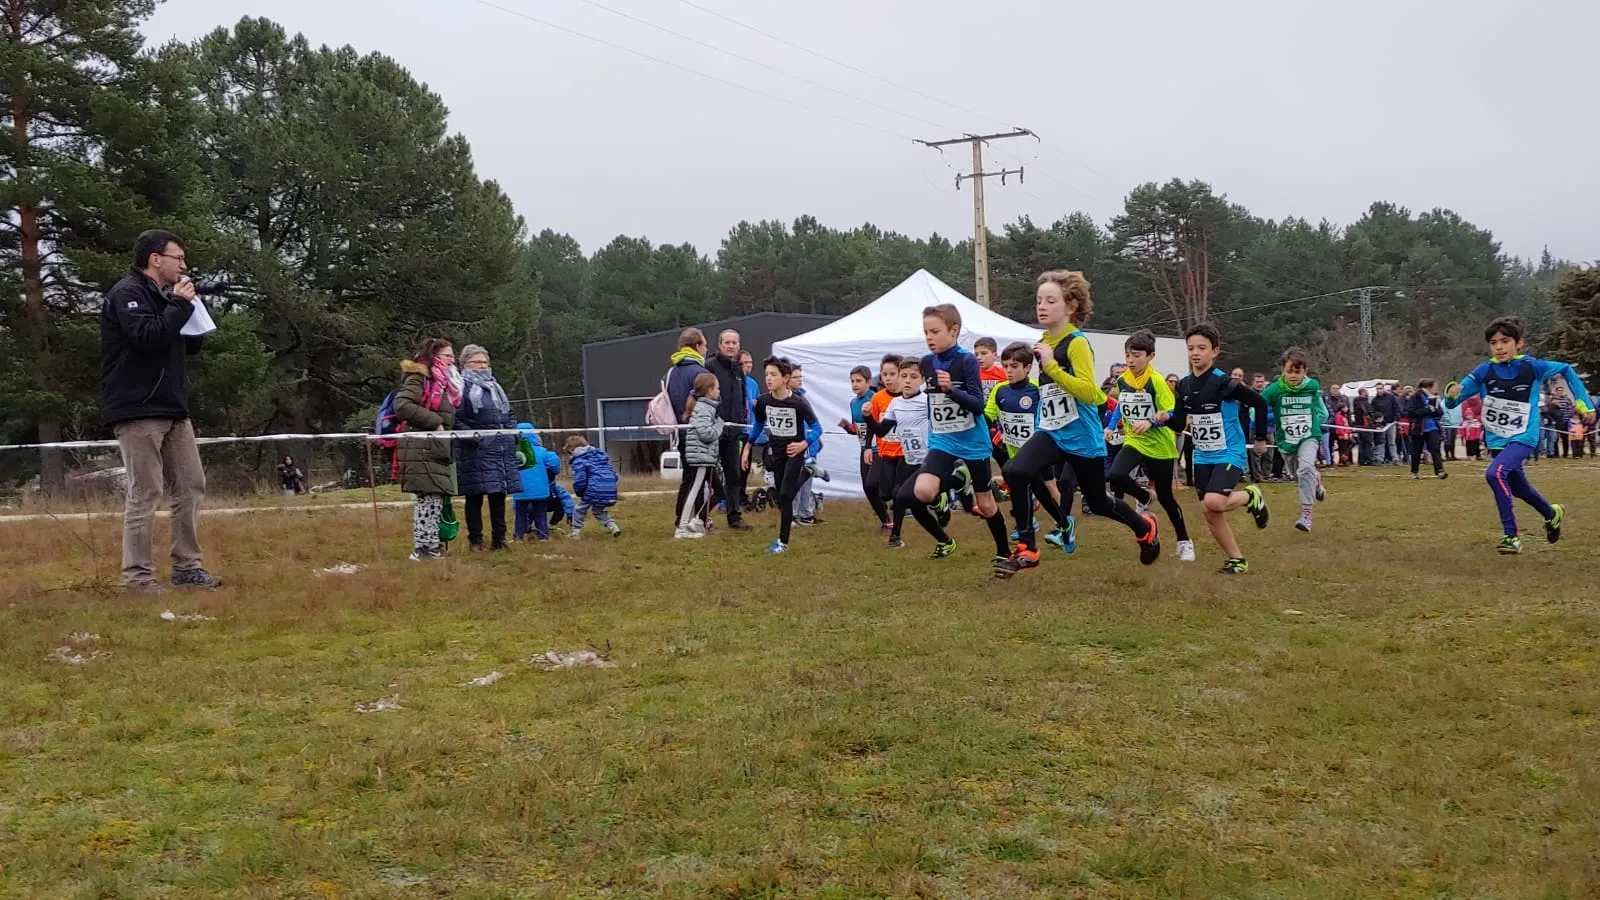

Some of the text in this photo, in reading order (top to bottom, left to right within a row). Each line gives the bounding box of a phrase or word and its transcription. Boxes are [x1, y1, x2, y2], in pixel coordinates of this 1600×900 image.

[933, 406, 969, 422] 624
[1041, 396, 1070, 418] 611
[1122, 404, 1152, 417] 647
[769, 416, 793, 428] 675
[1485, 409, 1523, 429] 584
[1003, 422, 1030, 438] 645
[1192, 426, 1221, 440] 625
